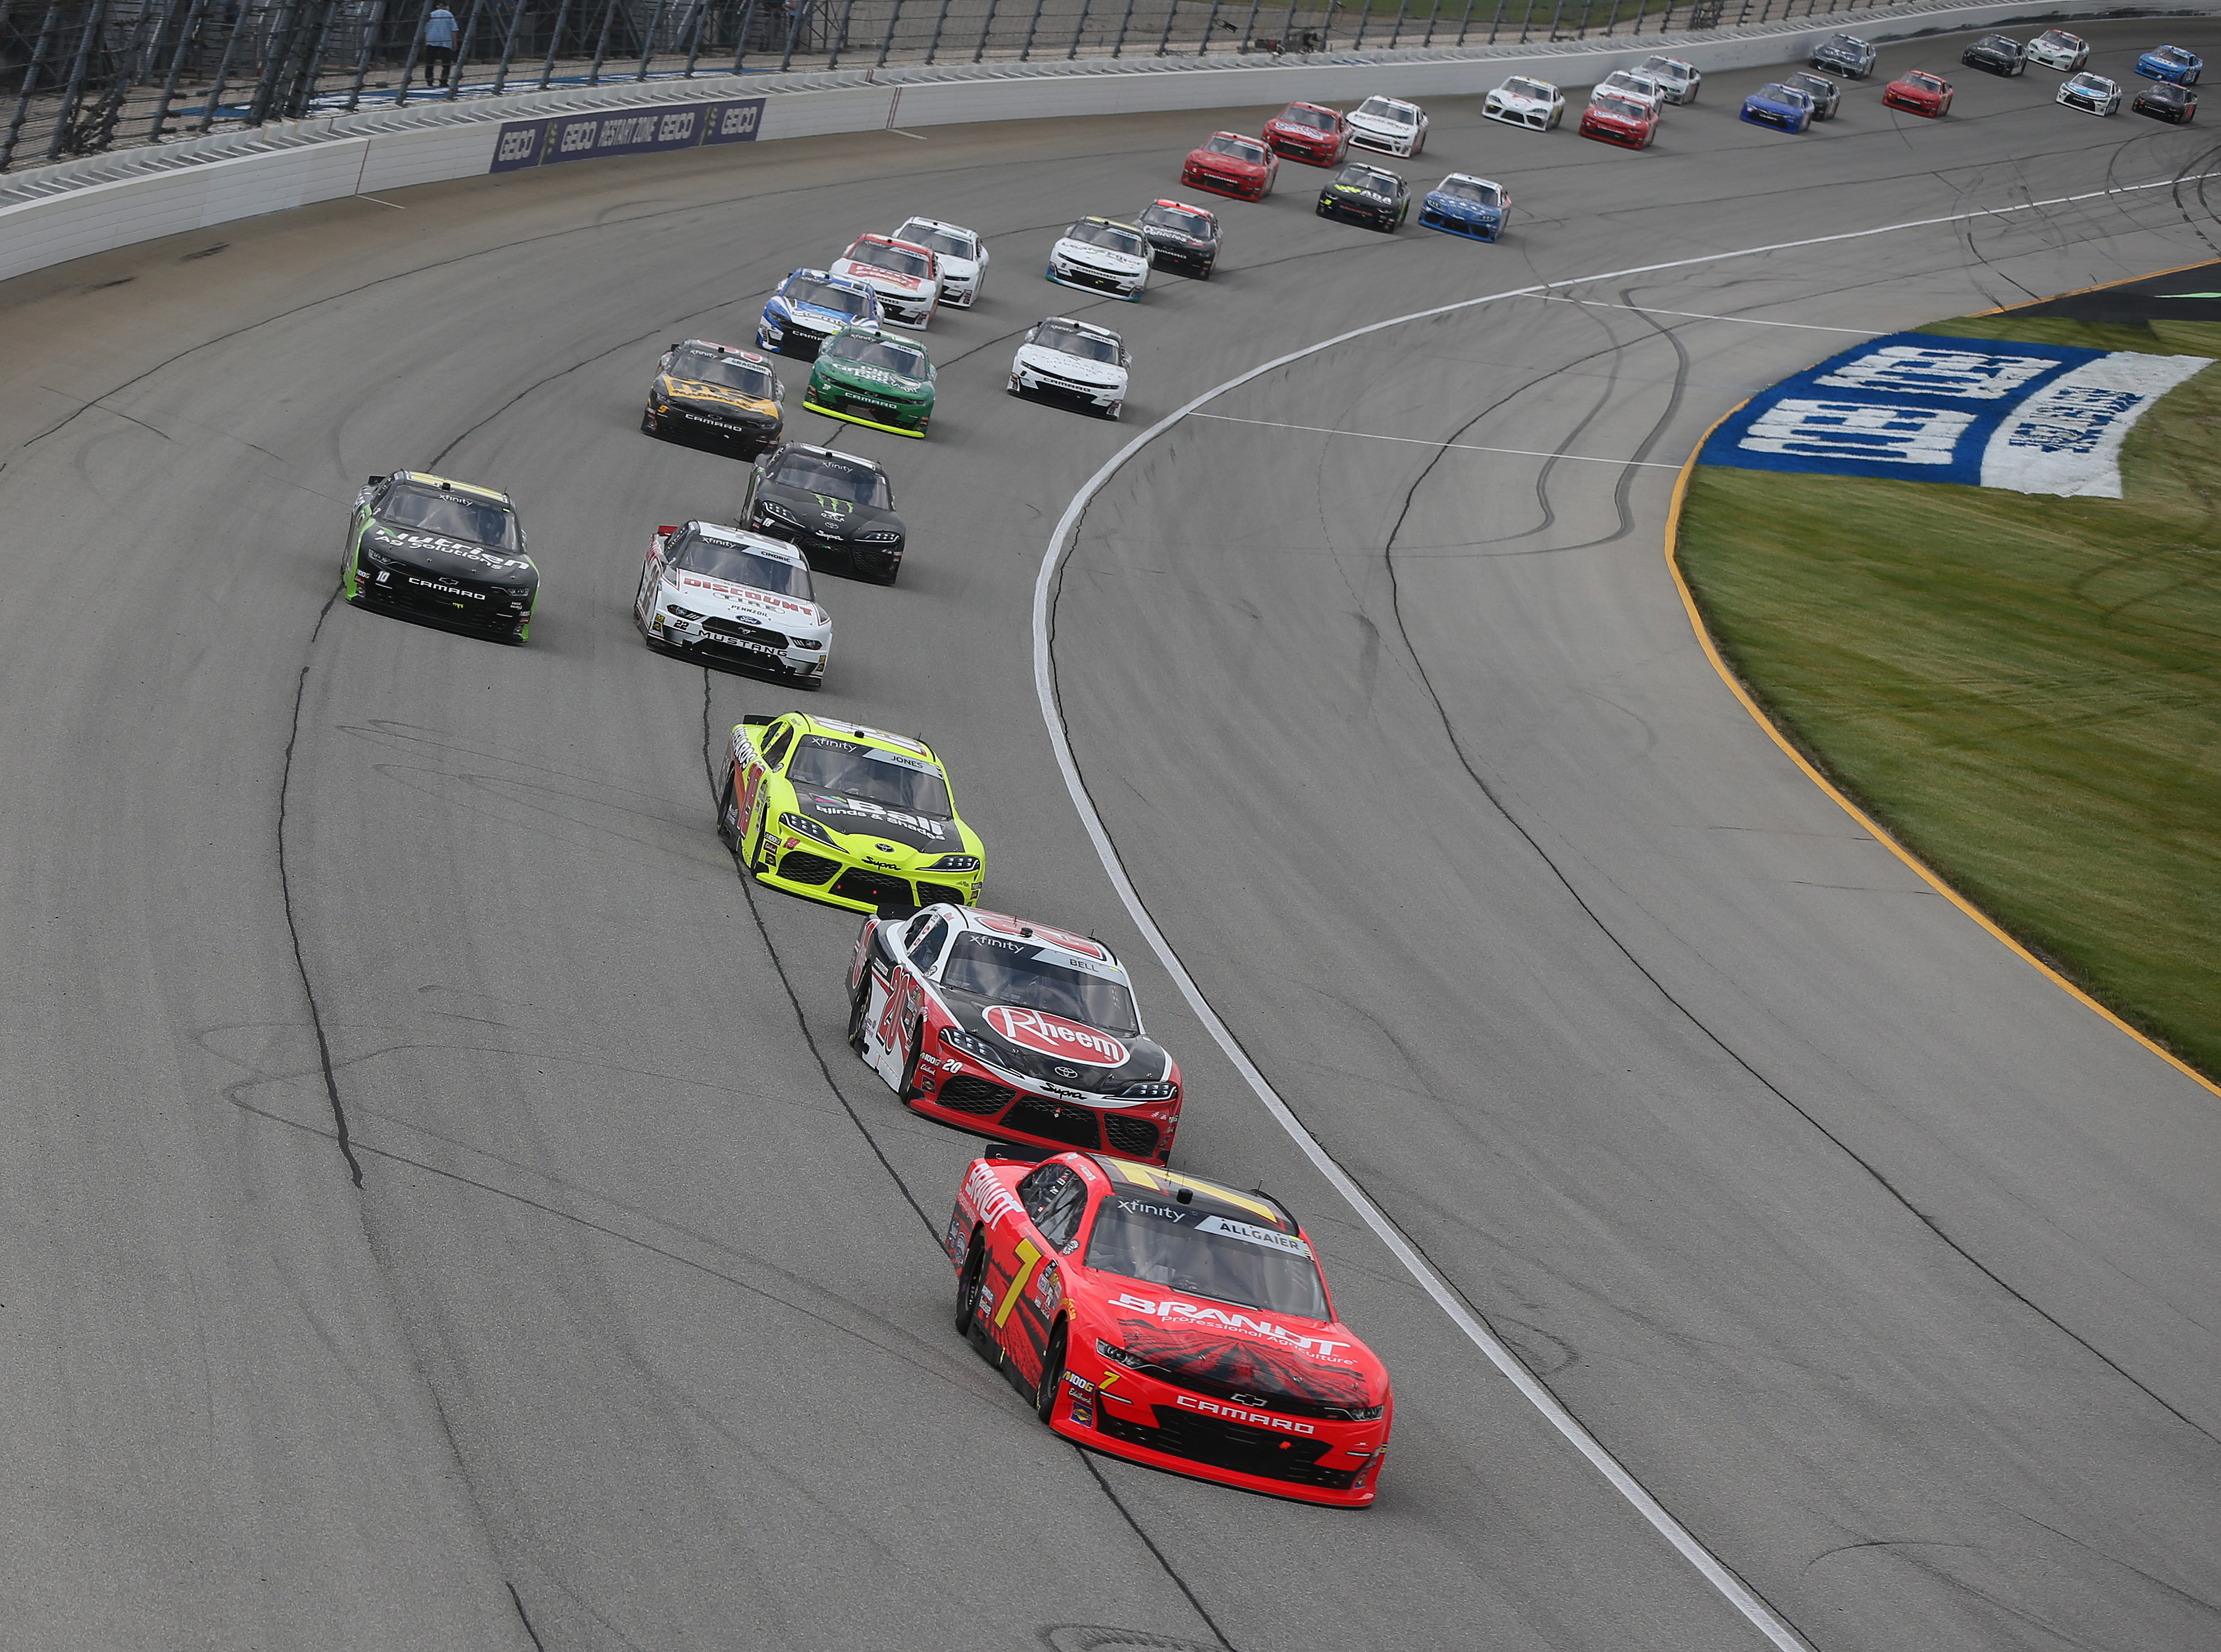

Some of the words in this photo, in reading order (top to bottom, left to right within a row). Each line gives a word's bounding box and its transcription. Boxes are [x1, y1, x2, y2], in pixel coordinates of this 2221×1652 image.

[721, 107, 757, 135] GEICO
[560, 121, 598, 152] GEICO
[598, 120, 634, 147] RESTART
[634, 116, 658, 142] ZONE
[658, 112, 695, 142] GEICO
[498, 129, 536, 162] GEICO
[845, 392, 897, 409] CAMARO
[686, 413, 742, 433] CAMARO
[822, 461, 853, 474] xfinity
[439, 494, 472, 507] xfinity
[375, 530, 530, 570] Nutrien
[702, 537, 736, 549] xfinity
[409, 541, 503, 570] Solutions
[760, 550, 791, 563] CINDRIC
[376, 570, 391, 583] 10
[408, 577, 486, 600] CAMARO
[683, 577, 813, 616] DISCOUNT
[731, 604, 769, 618] PENNZOIL
[673, 619, 690, 631] 22
[698, 629, 788, 657] MUSTANG
[811, 737, 857, 753] xfinity
[891, 755, 923, 769] JONES
[846, 797, 944, 836] Bali
[861, 856, 901, 871] Supra
[969, 934, 1025, 954] xfinity
[1069, 958, 1099, 973] BELL
[1000, 1006, 1120, 1061] Rheem
[920, 1052, 942, 1067] MOOG
[941, 1058, 963, 1074] 20
[1039, 1082, 1087, 1099] Supra
[1117, 1199, 1186, 1223] xfinity
[1219, 1222, 1300, 1251] ALLGAIER
[994, 1237, 1042, 1329] 7
[1108, 1293, 1351, 1356] BRANDT
[1062, 1371, 1095, 1393] MOOG
[1098, 1370, 1121, 1390] 7
[1176, 1394, 1315, 1435] CAMARO
